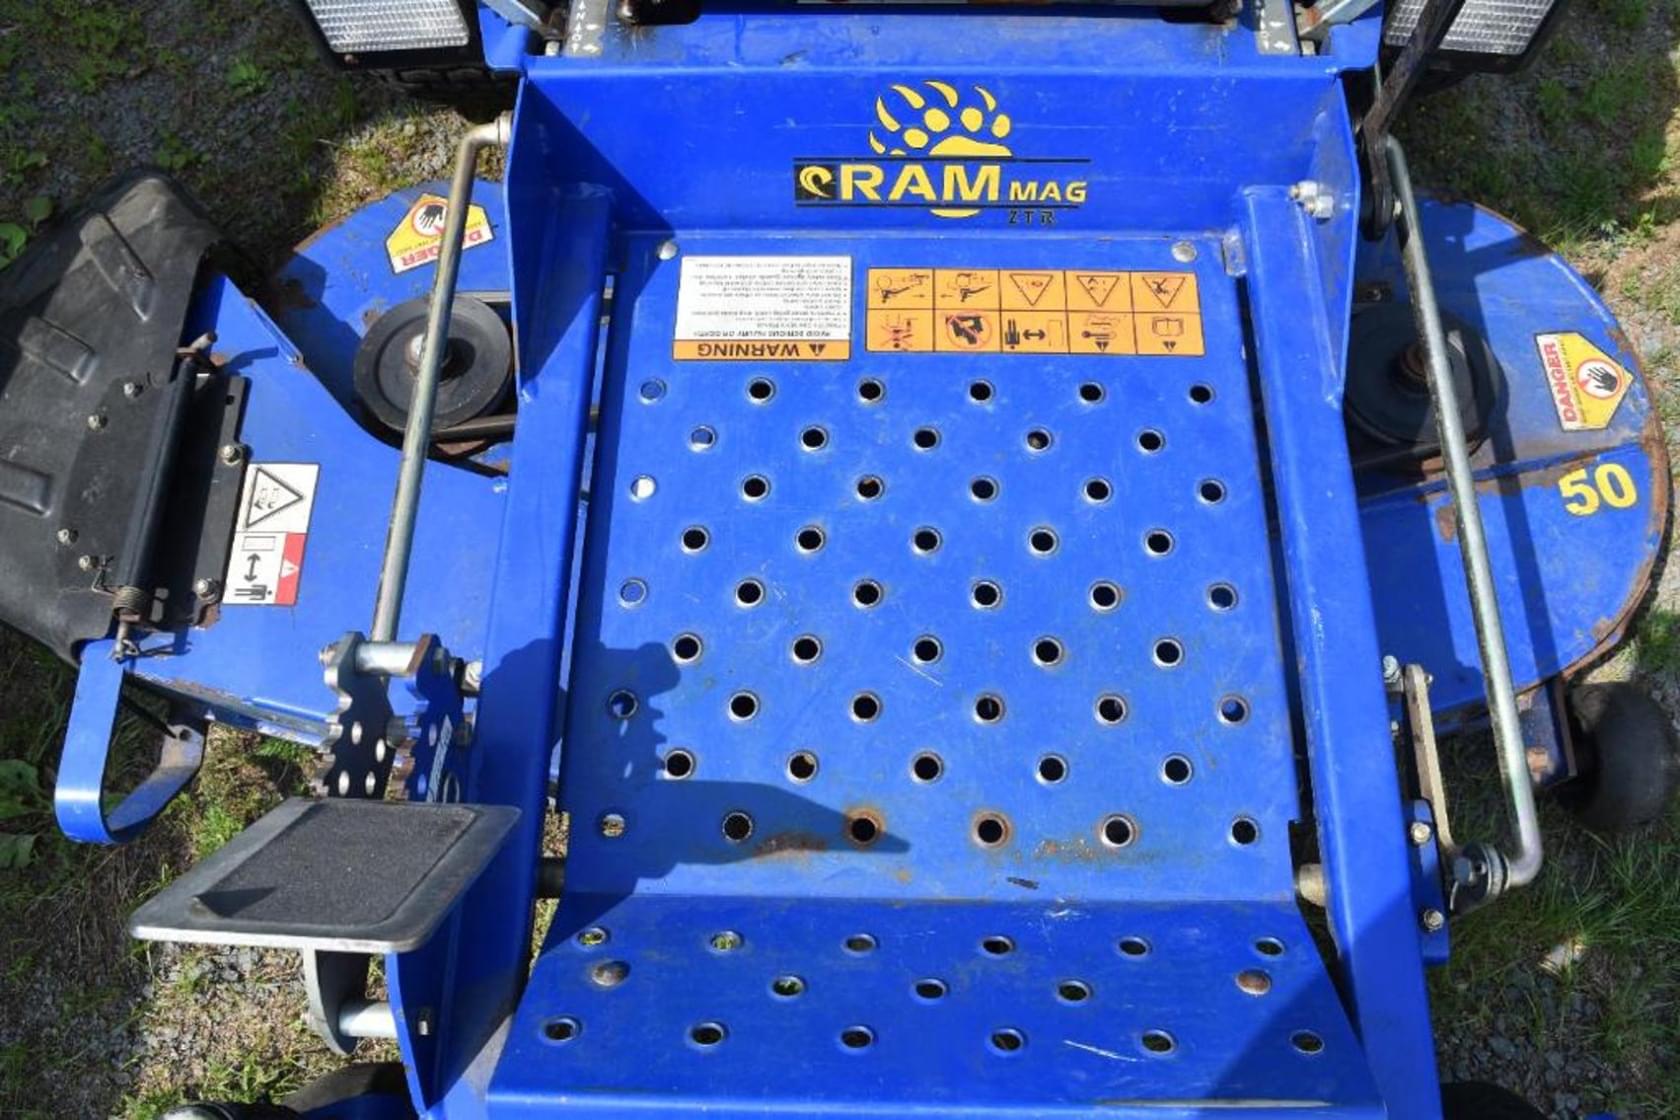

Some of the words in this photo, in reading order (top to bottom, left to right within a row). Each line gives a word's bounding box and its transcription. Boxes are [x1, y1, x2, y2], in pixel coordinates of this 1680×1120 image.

[839, 163, 1001, 202] RAM
[1009, 181, 1087, 203] MAG
[1008, 209, 1056, 225] ZTR
[401, 230, 482, 266] DGER
[697, 343, 800, 357] WARNING
[1544, 343, 1577, 422] DANGER
[1558, 464, 1637, 515] 50
